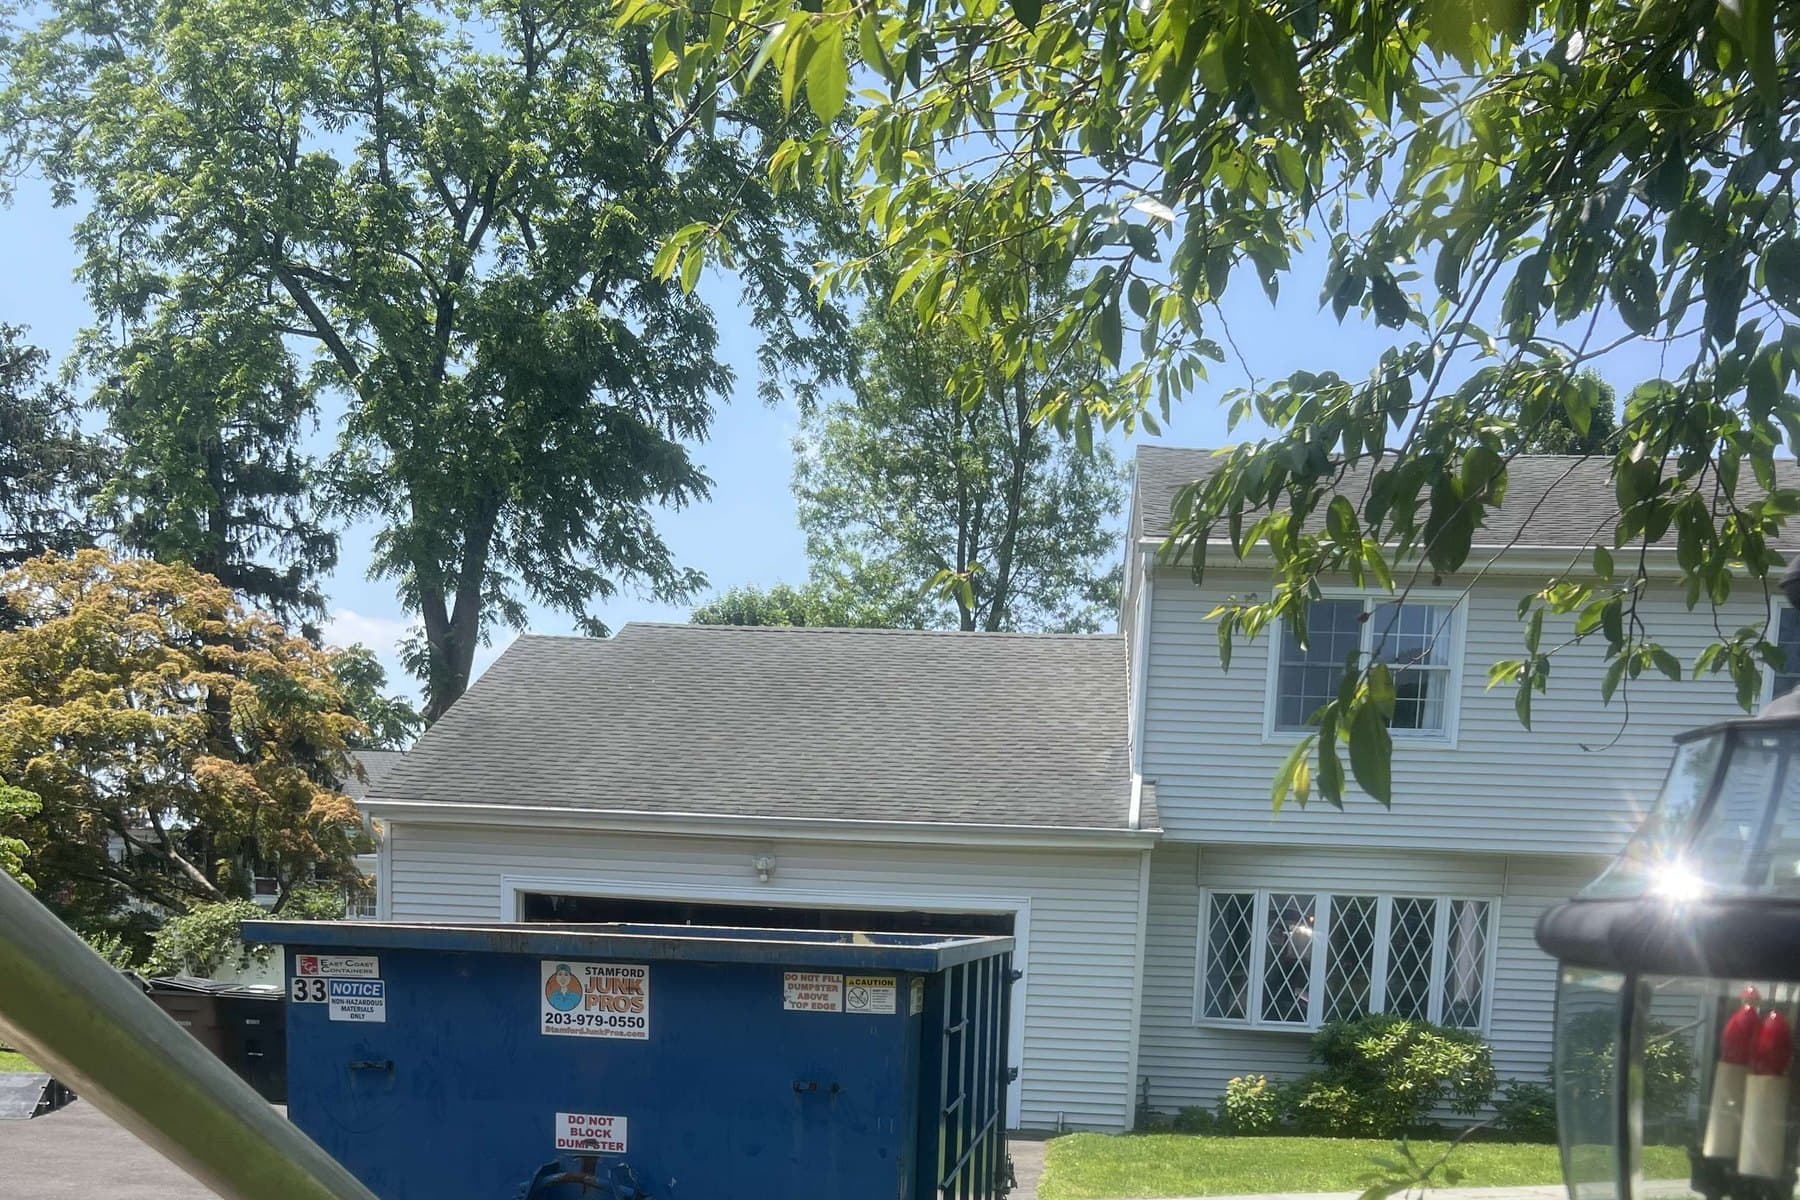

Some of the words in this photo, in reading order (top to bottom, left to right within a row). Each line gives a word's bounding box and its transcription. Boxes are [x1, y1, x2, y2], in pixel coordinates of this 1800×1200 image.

[585, 966, 645, 978] STAMFORD
[784, 973, 798, 981] DO
[800, 974, 820, 982] NOT
[822, 975, 842, 983] FILL
[294, 979, 327, 1002] 33
[332, 983, 381, 996] NOTICE
[585, 976, 645, 995] JUNK
[787, 983, 839, 992] DUMPSTER
[797, 992, 829, 1001] ABOVE
[331, 998, 383, 1007] NON-HAZARDOUS
[585, 994, 645, 1013] PROS
[790, 1001, 809, 1009] TOP
[811, 1002, 836, 1010] EDGE
[545, 1012, 645, 1028] 203-979-0550
[568, 1115, 585, 1125] DO
[588, 1116, 615, 1126] NOT
[570, 1127, 612, 1138] BLOCK
